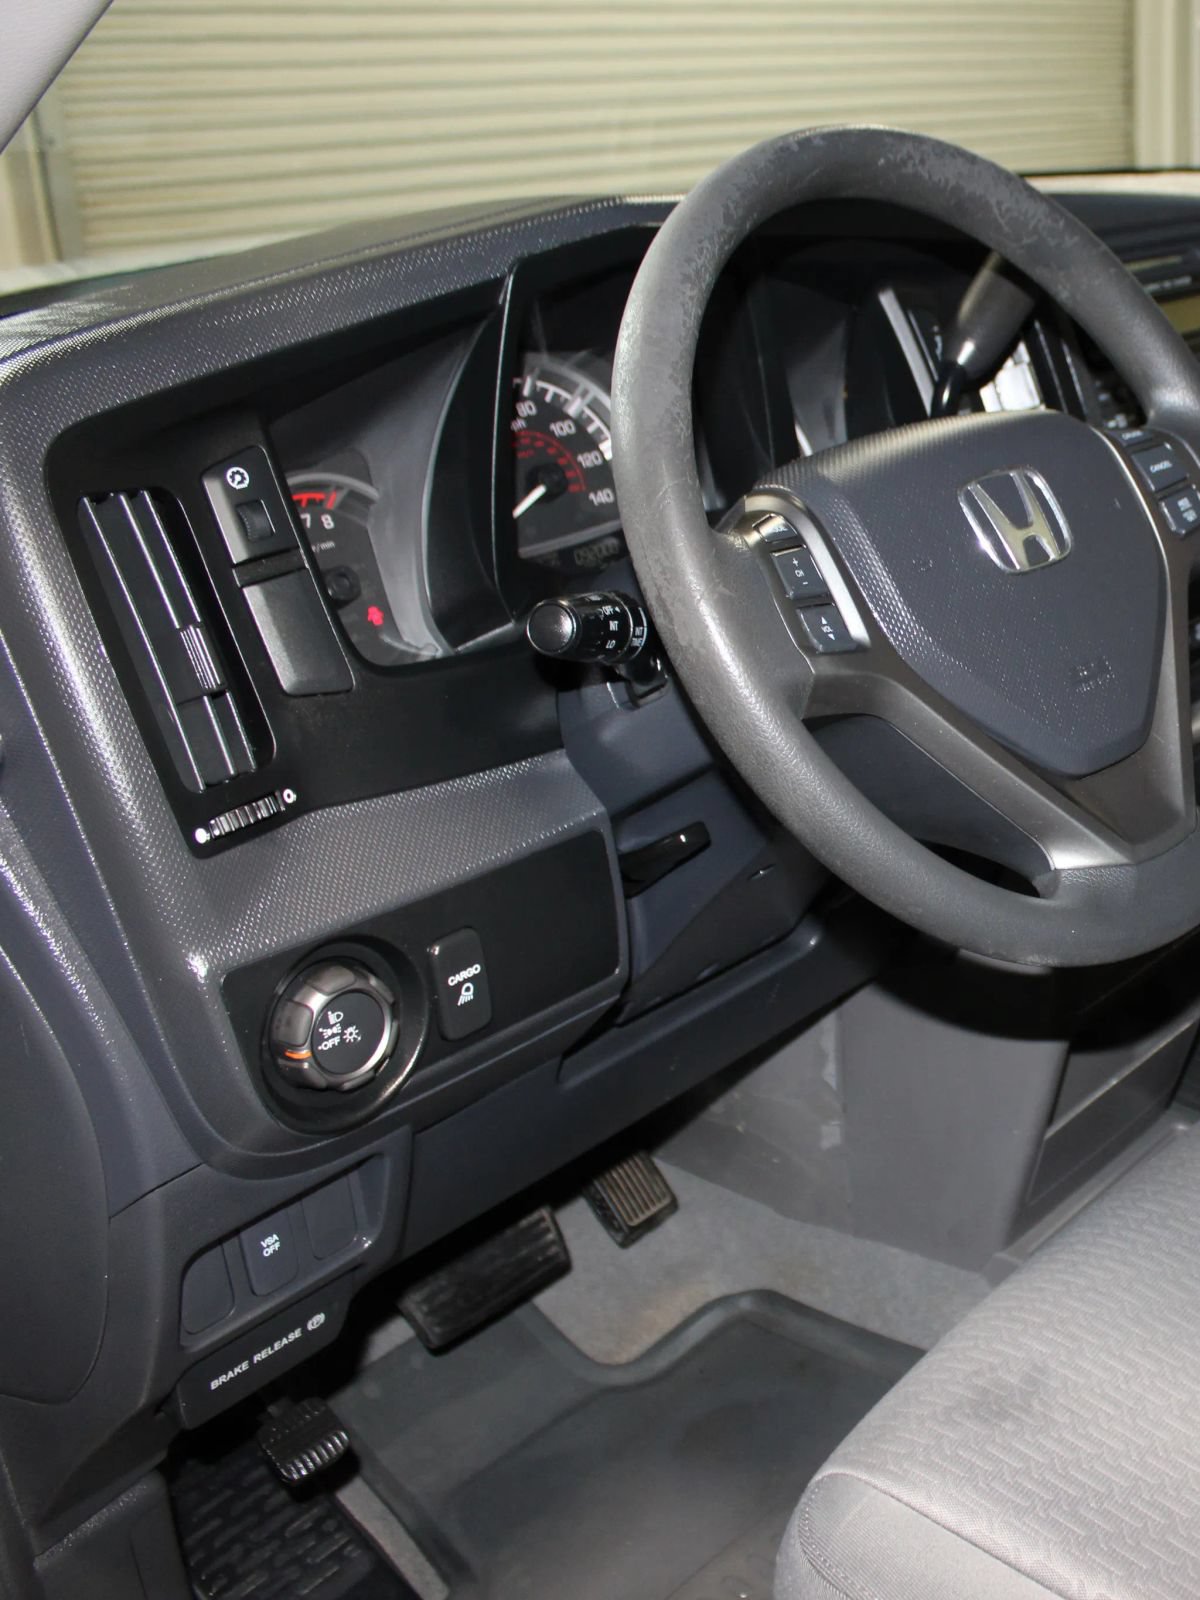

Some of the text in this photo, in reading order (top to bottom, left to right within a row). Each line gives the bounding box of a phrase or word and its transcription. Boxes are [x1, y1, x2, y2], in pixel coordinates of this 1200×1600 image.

[549, 419, 576, 437] 100
[577, 450, 603, 468] 120
[588, 488, 615, 506] 140
[300, 513, 335, 529] 7 8
[447, 963, 481, 986] CARGO
[322, 1036, 341, 1050] OFF
[260, 1233, 279, 1248] VSA
[262, 1241, 281, 1257] OFF
[210, 1327, 302, 1390] BRAKE RELEASE
